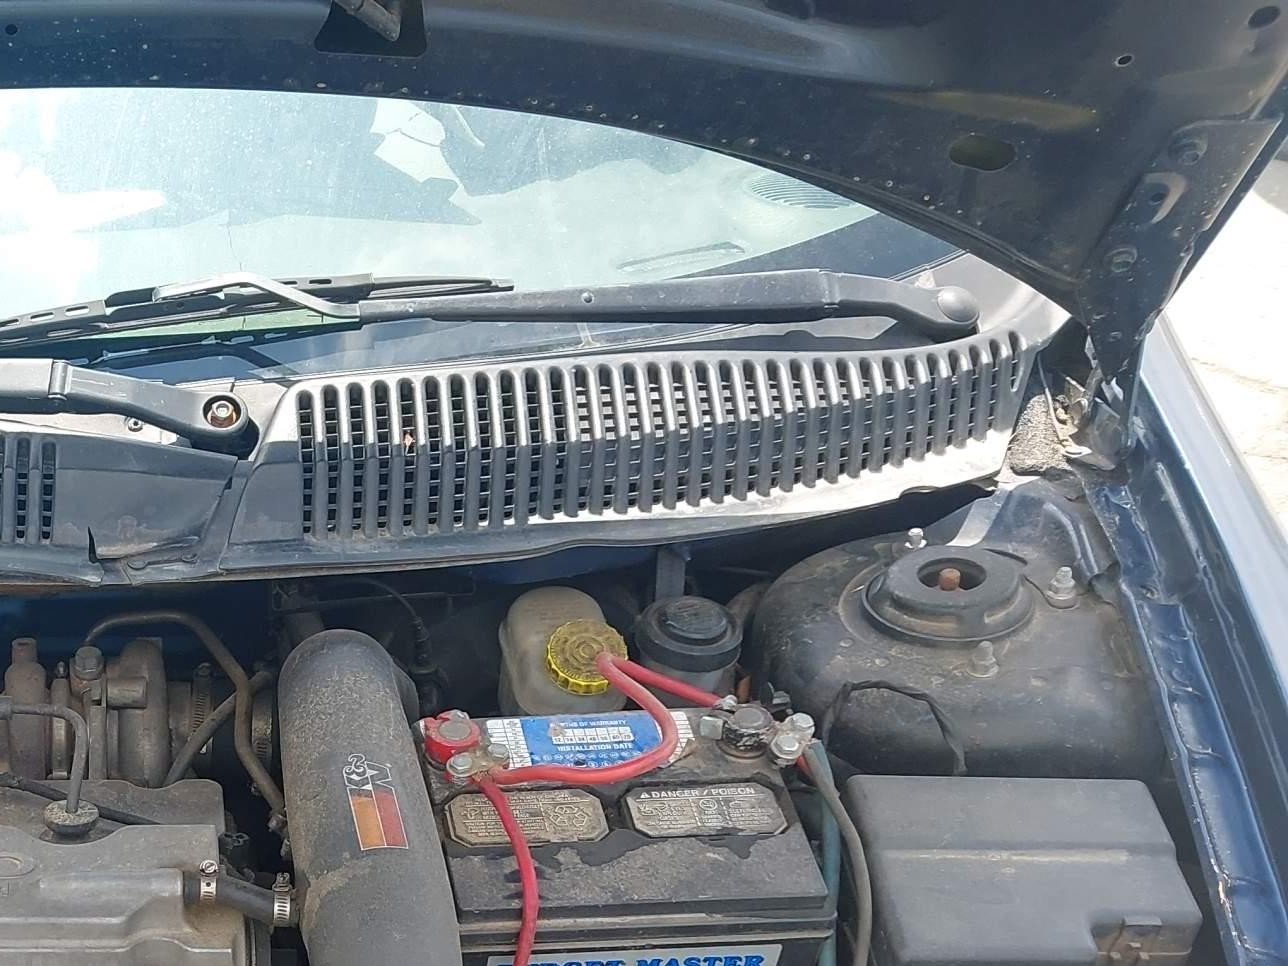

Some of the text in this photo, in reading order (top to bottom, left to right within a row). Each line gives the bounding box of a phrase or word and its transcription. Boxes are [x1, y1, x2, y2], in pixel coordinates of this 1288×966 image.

[557, 742, 634, 751] INSTALLATION DATE
[652, 790, 699, 798] DANGER
[711, 787, 755, 796] POISON
